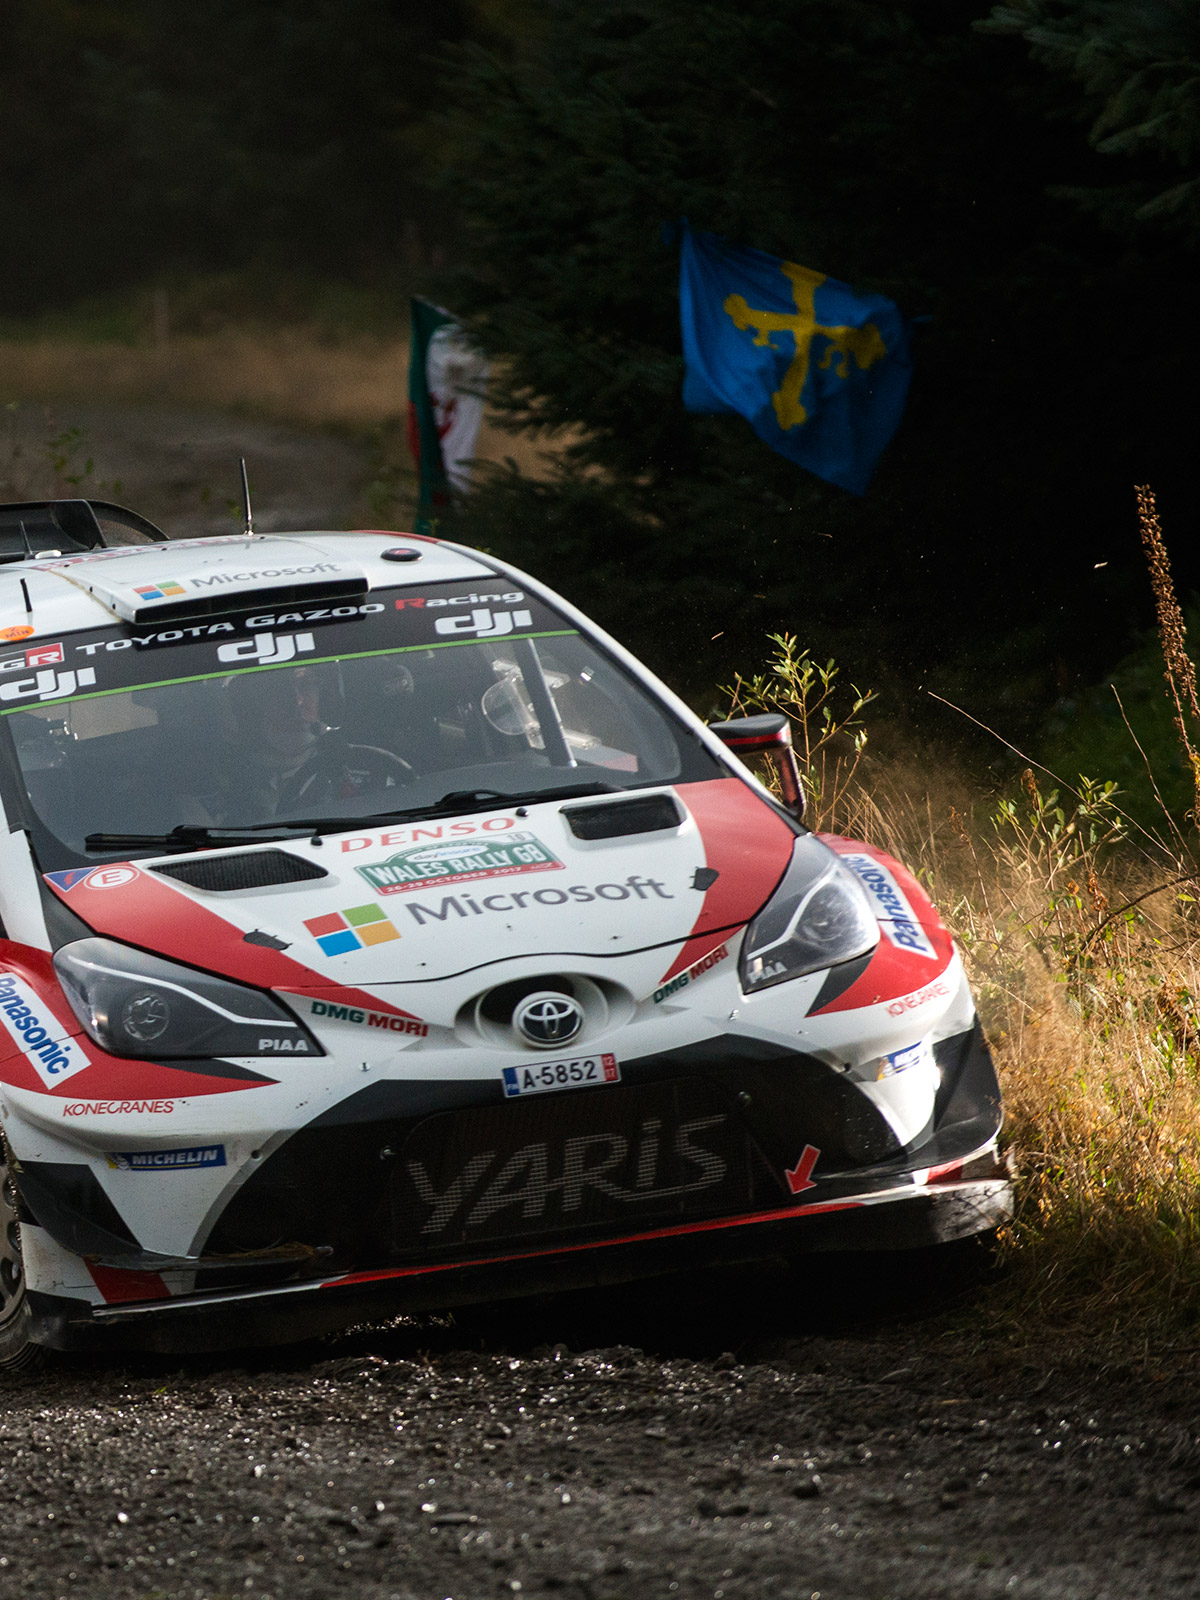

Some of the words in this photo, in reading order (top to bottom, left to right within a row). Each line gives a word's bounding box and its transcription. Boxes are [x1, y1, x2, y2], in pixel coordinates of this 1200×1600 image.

[190, 563, 341, 588] Microsoft
[75, 621, 235, 656] TOYOTA
[245, 603, 385, 628] GAZOO
[394, 591, 525, 611] Racing
[340, 817, 515, 853] DENSO
[366, 861, 449, 886] WALES
[450, 850, 513, 873] RALLY
[513, 844, 548, 863] GB
[425, 871, 488, 886] OCTOBER
[493, 866, 522, 876] 2017
[405, 875, 676, 926] Microsoft
[653, 972, 689, 1004] DMG
[689, 944, 729, 980] MORI
[311, 1001, 364, 1024] DMG
[367, 1013, 428, 1037] MORI
[258, 1039, 309, 1051] PIAA
[62, 1100, 174, 1117] KONECRANES
[132, 1149, 218, 1165] MICHELIN
